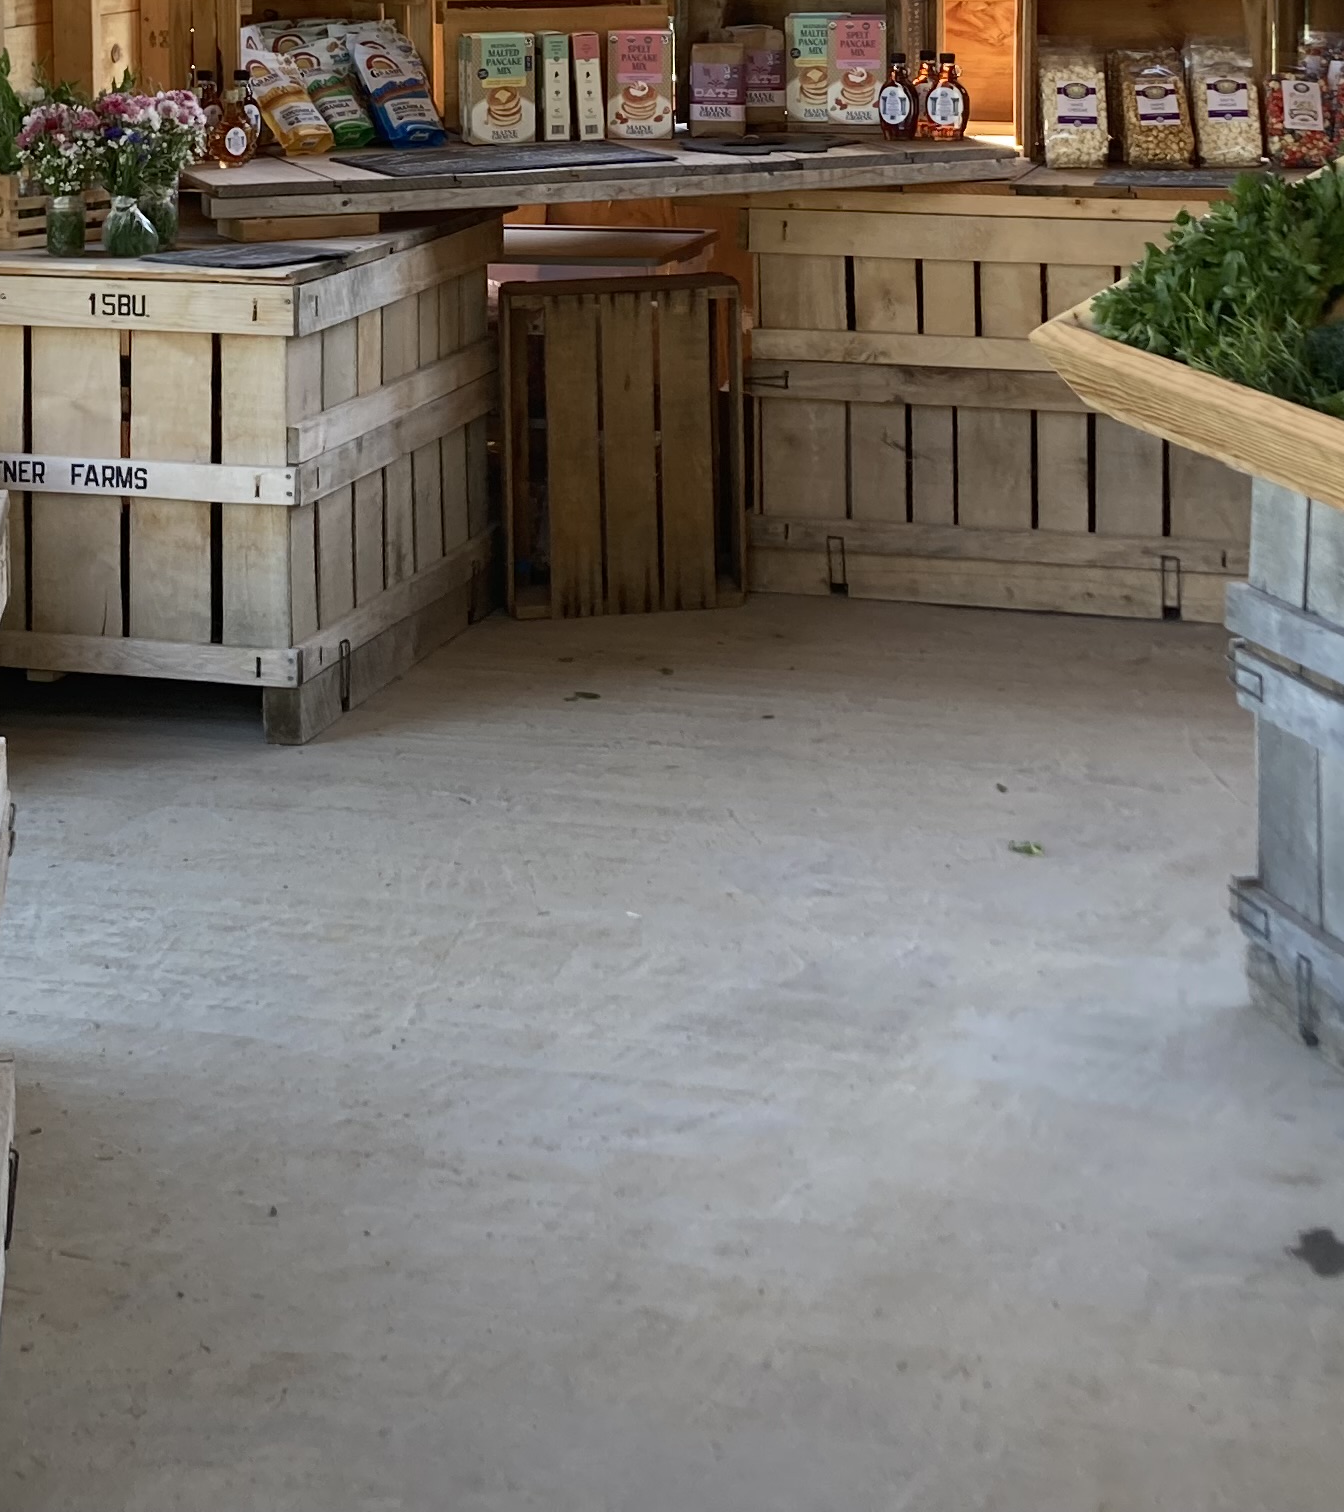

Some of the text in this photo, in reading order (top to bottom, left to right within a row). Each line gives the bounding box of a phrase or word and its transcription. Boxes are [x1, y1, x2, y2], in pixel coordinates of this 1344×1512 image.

[800, 29, 828, 37] MALTE
[798, 38, 828, 46] PANCAK
[840, 39, 876, 48] PANCAKE
[488, 49, 520, 57] MALTED
[808, 46, 823, 54] MIX
[850, 48, 865, 56] MIX
[486, 57, 522, 66] PANCAKE
[621, 53, 658, 62] PANCAKE
[496, 66, 511, 75] MIX
[632, 62, 647, 71] MIX
[694, 88, 738, 98] OATS
[70, 463, 148, 490] FARMS
